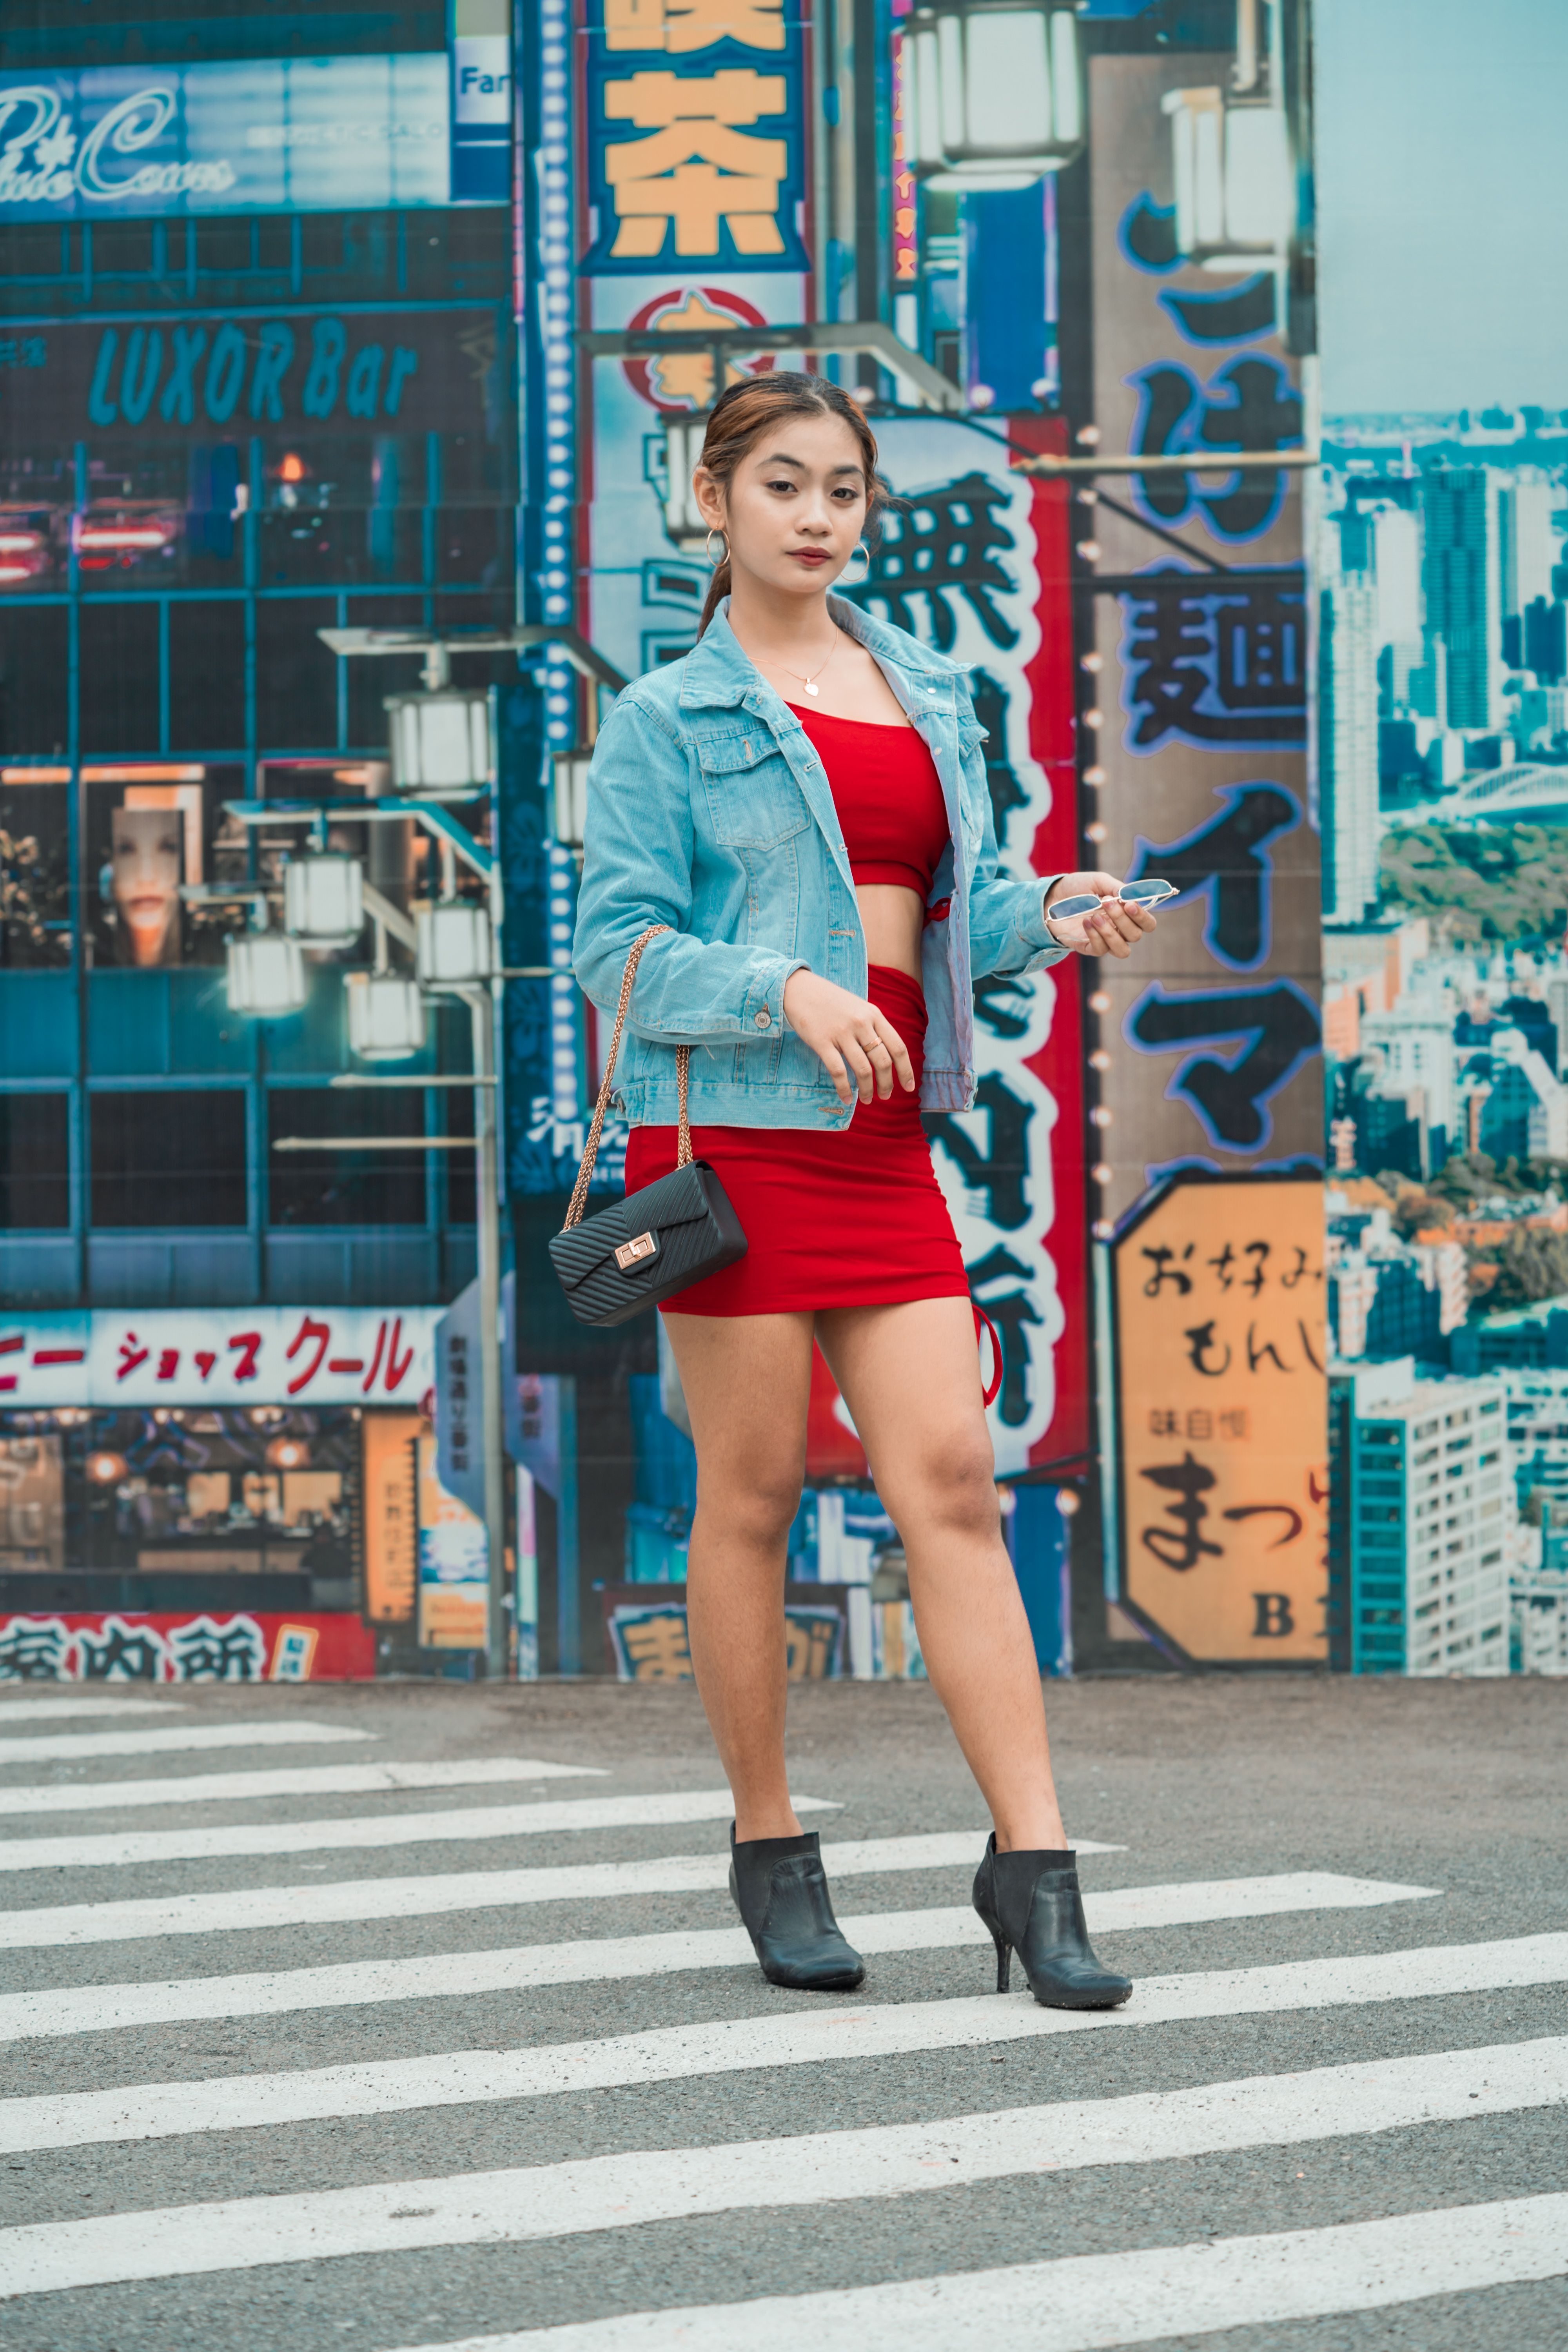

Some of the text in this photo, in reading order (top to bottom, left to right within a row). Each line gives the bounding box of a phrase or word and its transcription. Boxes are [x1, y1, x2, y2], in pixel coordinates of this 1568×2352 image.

[89, 317, 417, 427] LUXOR Bar
[1139, 1448, 1329, 1572] まつ
